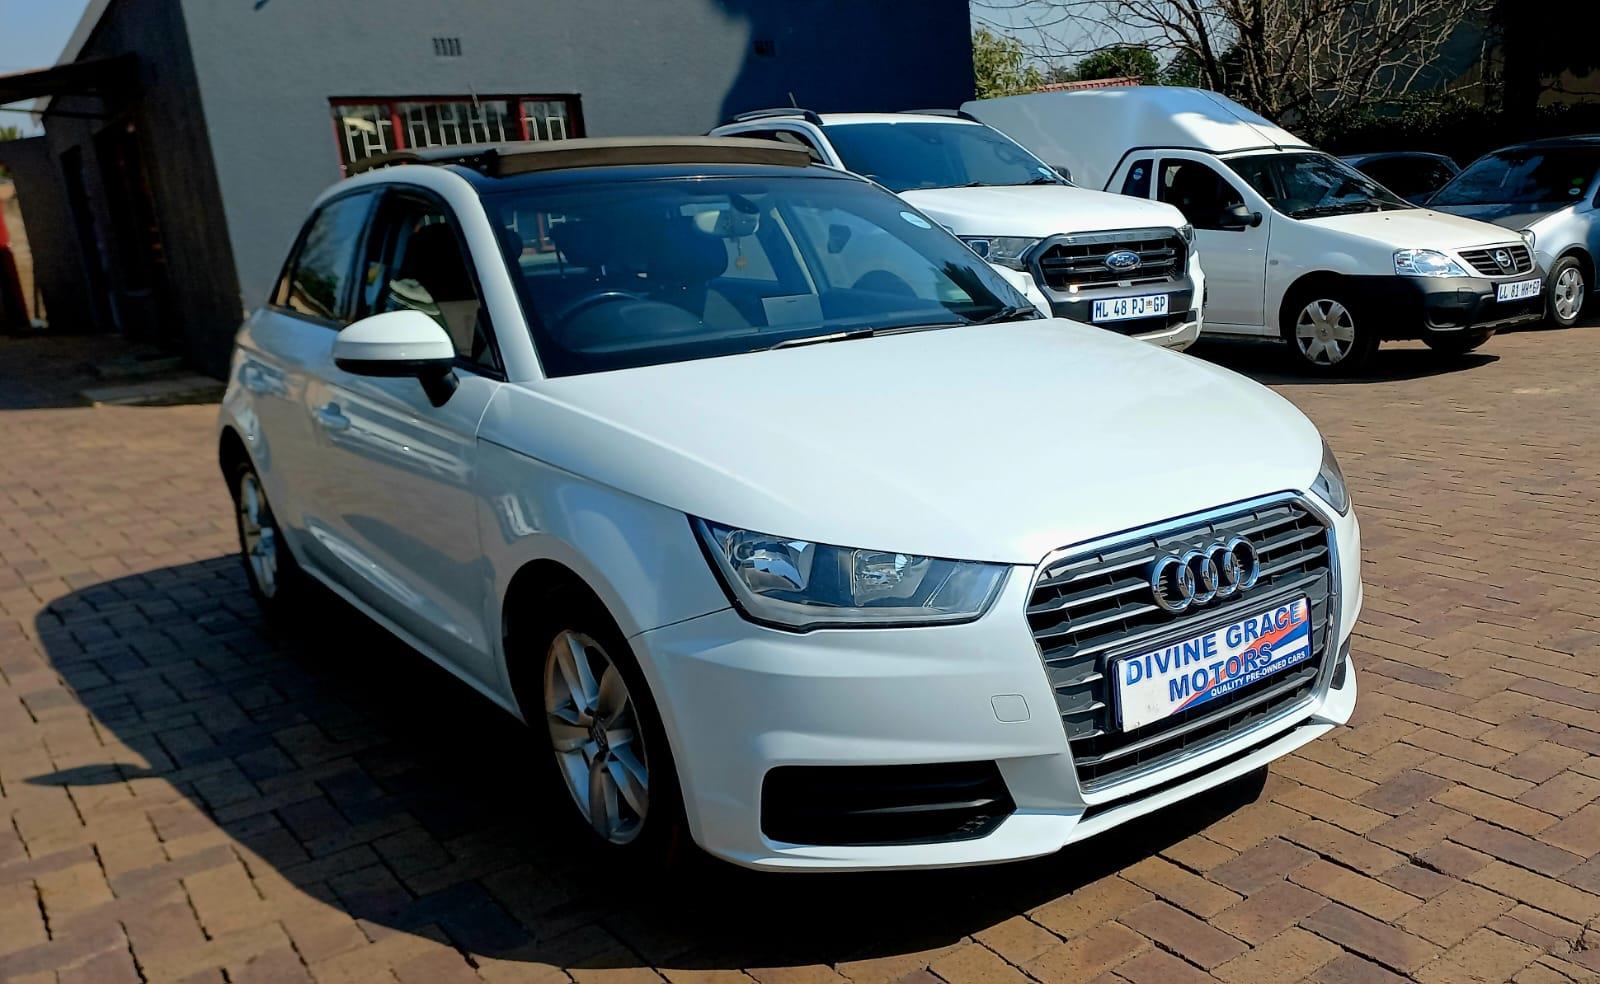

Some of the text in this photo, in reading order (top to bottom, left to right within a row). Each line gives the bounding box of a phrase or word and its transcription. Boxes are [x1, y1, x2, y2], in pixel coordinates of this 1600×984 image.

[1114, 300, 1127, 317] 48
[1132, 297, 1145, 315] PJ
[1153, 296, 1166, 312] GP
[1126, 602, 1301, 686] DIVINE GRACE
[1169, 643, 1273, 702] MOTORS
[1211, 651, 1305, 697] QUALITY PRE-OWNED CARS
